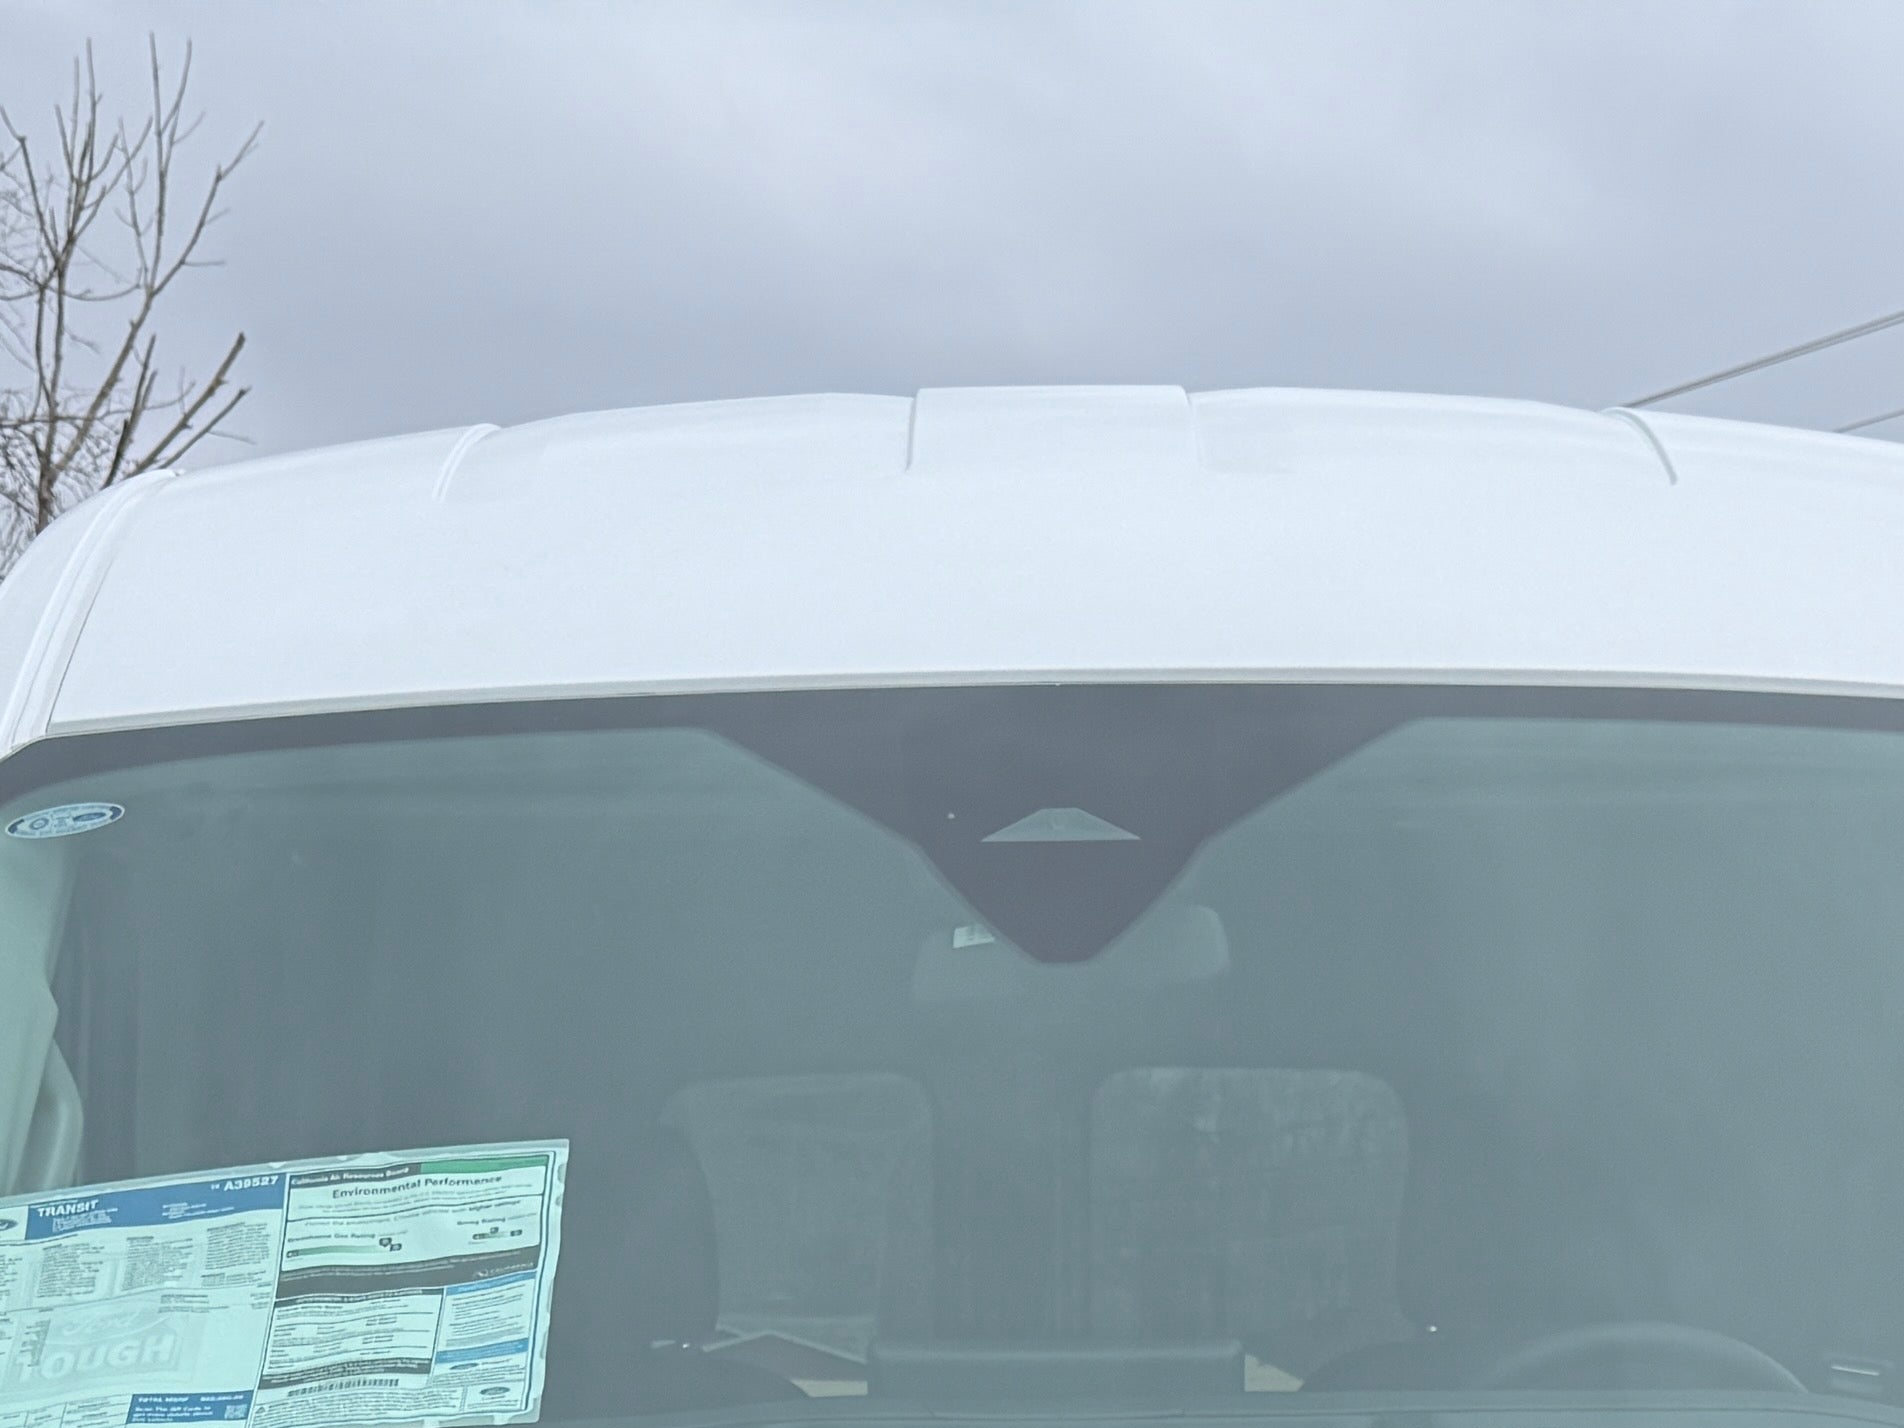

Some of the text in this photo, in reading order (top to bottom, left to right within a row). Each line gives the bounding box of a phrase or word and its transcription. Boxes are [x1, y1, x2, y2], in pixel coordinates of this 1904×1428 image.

[332, 1179, 421, 1199] Environmental
[425, 1176, 502, 1187] Performance
[37, 1200, 99, 1217] TRANSIT
[14, 1333, 176, 1383] TOUGH
